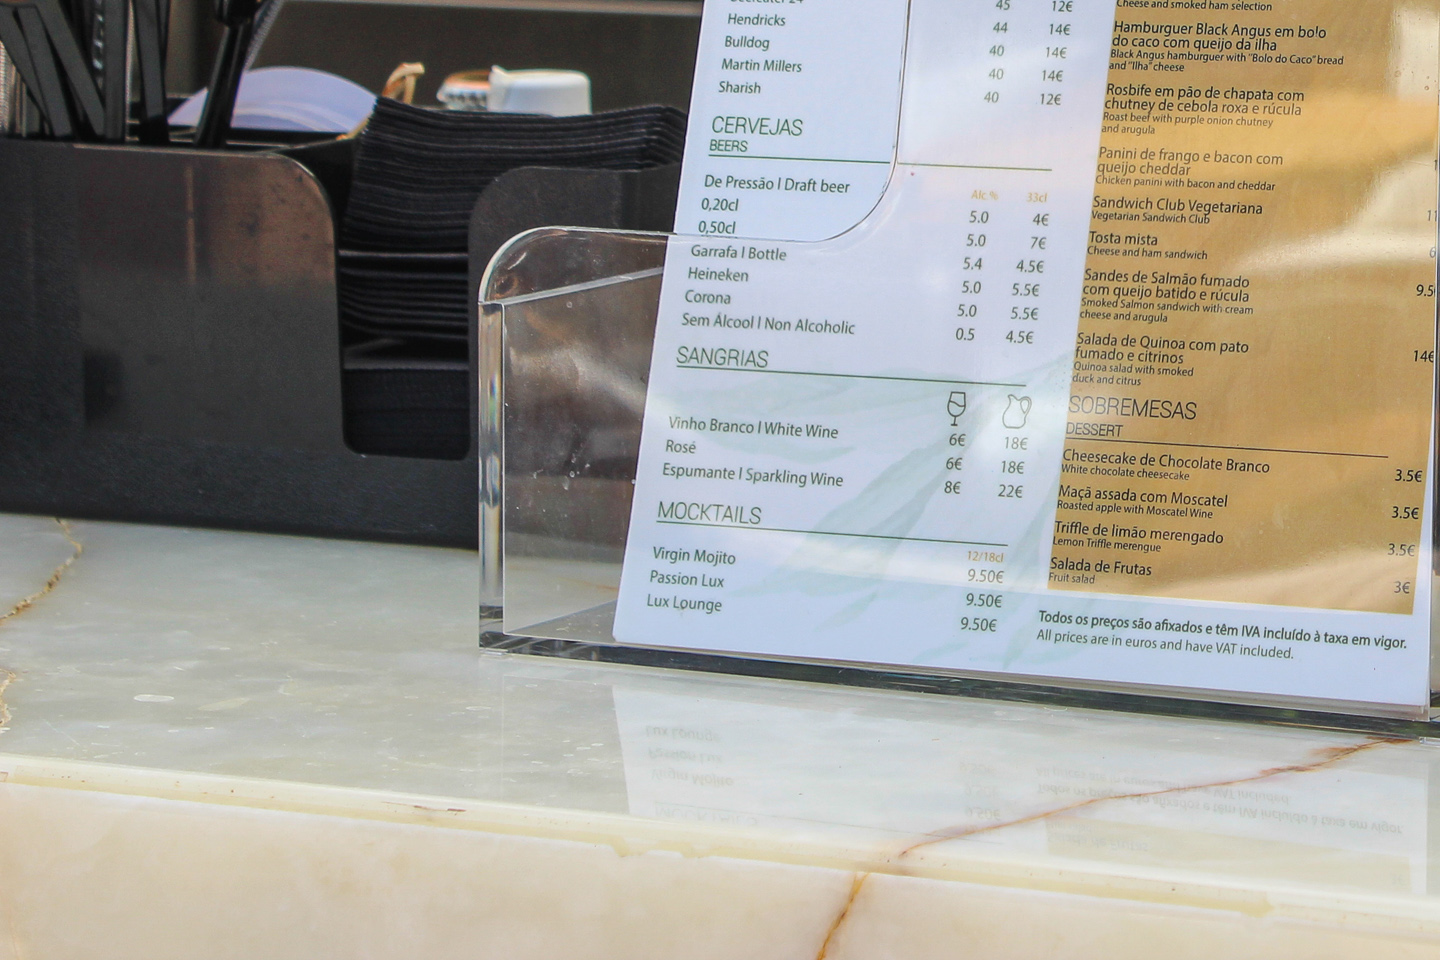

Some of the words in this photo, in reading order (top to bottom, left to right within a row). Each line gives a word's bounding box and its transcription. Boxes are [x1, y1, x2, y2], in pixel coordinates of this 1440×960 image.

[728, 14, 785, 26] Hendricks
[725, 36, 770, 51] Bulldog
[722, 58, 760, 70] Martin
[764, 60, 802, 72] Millers
[719, 81, 760, 94] Sharish
[712, 116, 803, 136] CERVEJAS
[710, 139, 748, 152] BEERS
[705, 175, 722, 188] De
[726, 176, 774, 190] Pressão
[785, 178, 816, 192] Draft
[821, 179, 850, 193] beer
[702, 198, 738, 211] 0,20cl
[1093, 196, 1152, 209] Sandwich
[1157, 198, 1185, 211] Club
[1189, 200, 1262, 215] Vegetariana
[698, 221, 736, 234] 0,50cl
[1090, 231, 1120, 244] Tosta
[1125, 234, 1157, 245] mista
[691, 244, 737, 258] Garrafa
[748, 247, 786, 260] Bottle
[688, 267, 748, 282] Heineken
[685, 290, 730, 304] Corona
[682, 313, 709, 326] Sem
[714, 313, 754, 328] Álcool
[765, 317, 791, 330] Non
[795, 319, 855, 334] Alcoholic
[676, 346, 768, 366] SANGRIAS
[1069, 396, 1196, 420] SOBREMESAS
[670, 416, 706, 430] Vinho
[710, 418, 754, 433] Branco
[765, 422, 802, 436] White
[805, 424, 838, 438] Wine
[1066, 422, 1123, 437] DESSERT
[666, 440, 696, 454] Rosé
[1063, 449, 1136, 466] Cheesecake
[1140, 453, 1155, 466] de
[1159, 454, 1222, 470] Chocolate
[1226, 459, 1269, 473] Branco
[1395, 469, 1422, 482] 3.5€
[663, 463, 735, 480] Espumante
[746, 468, 807, 488] Sparkling
[811, 472, 843, 486] Wine
[658, 501, 761, 524] MOCKTAILS
[654, 546, 690, 564] Virgin
[694, 549, 736, 566] Mojito
[968, 569, 1004, 583] 9.50€
[1050, 557, 1090, 571] Salada
[1095, 560, 1110, 573] de
[1114, 562, 1151, 575] Frutas
[1394, 581, 1410, 594] 3€
[650, 570, 697, 585] Passion
[702, 574, 724, 587] Lux
[966, 593, 1002, 608] 9.50€
[647, 594, 669, 607] Lux
[674, 596, 722, 614] Lounge
[961, 617, 997, 632] 9.50€
[1039, 610, 1072, 624] Todos
[1076, 616, 1088, 625] os
[1091, 617, 1129, 630] preços
[1132, 618, 1152, 630] são
[1155, 619, 1202, 633] afixados
[1206, 626, 1212, 634] e
[1216, 624, 1238, 636] têm
[1242, 625, 1260, 637] IVA
[1264, 627, 1311, 641] incluído
[1314, 630, 1320, 642] à
[1324, 632, 1348, 644] taxa
[1352, 636, 1370, 646] em
[1374, 636, 1406, 650] vigor.
